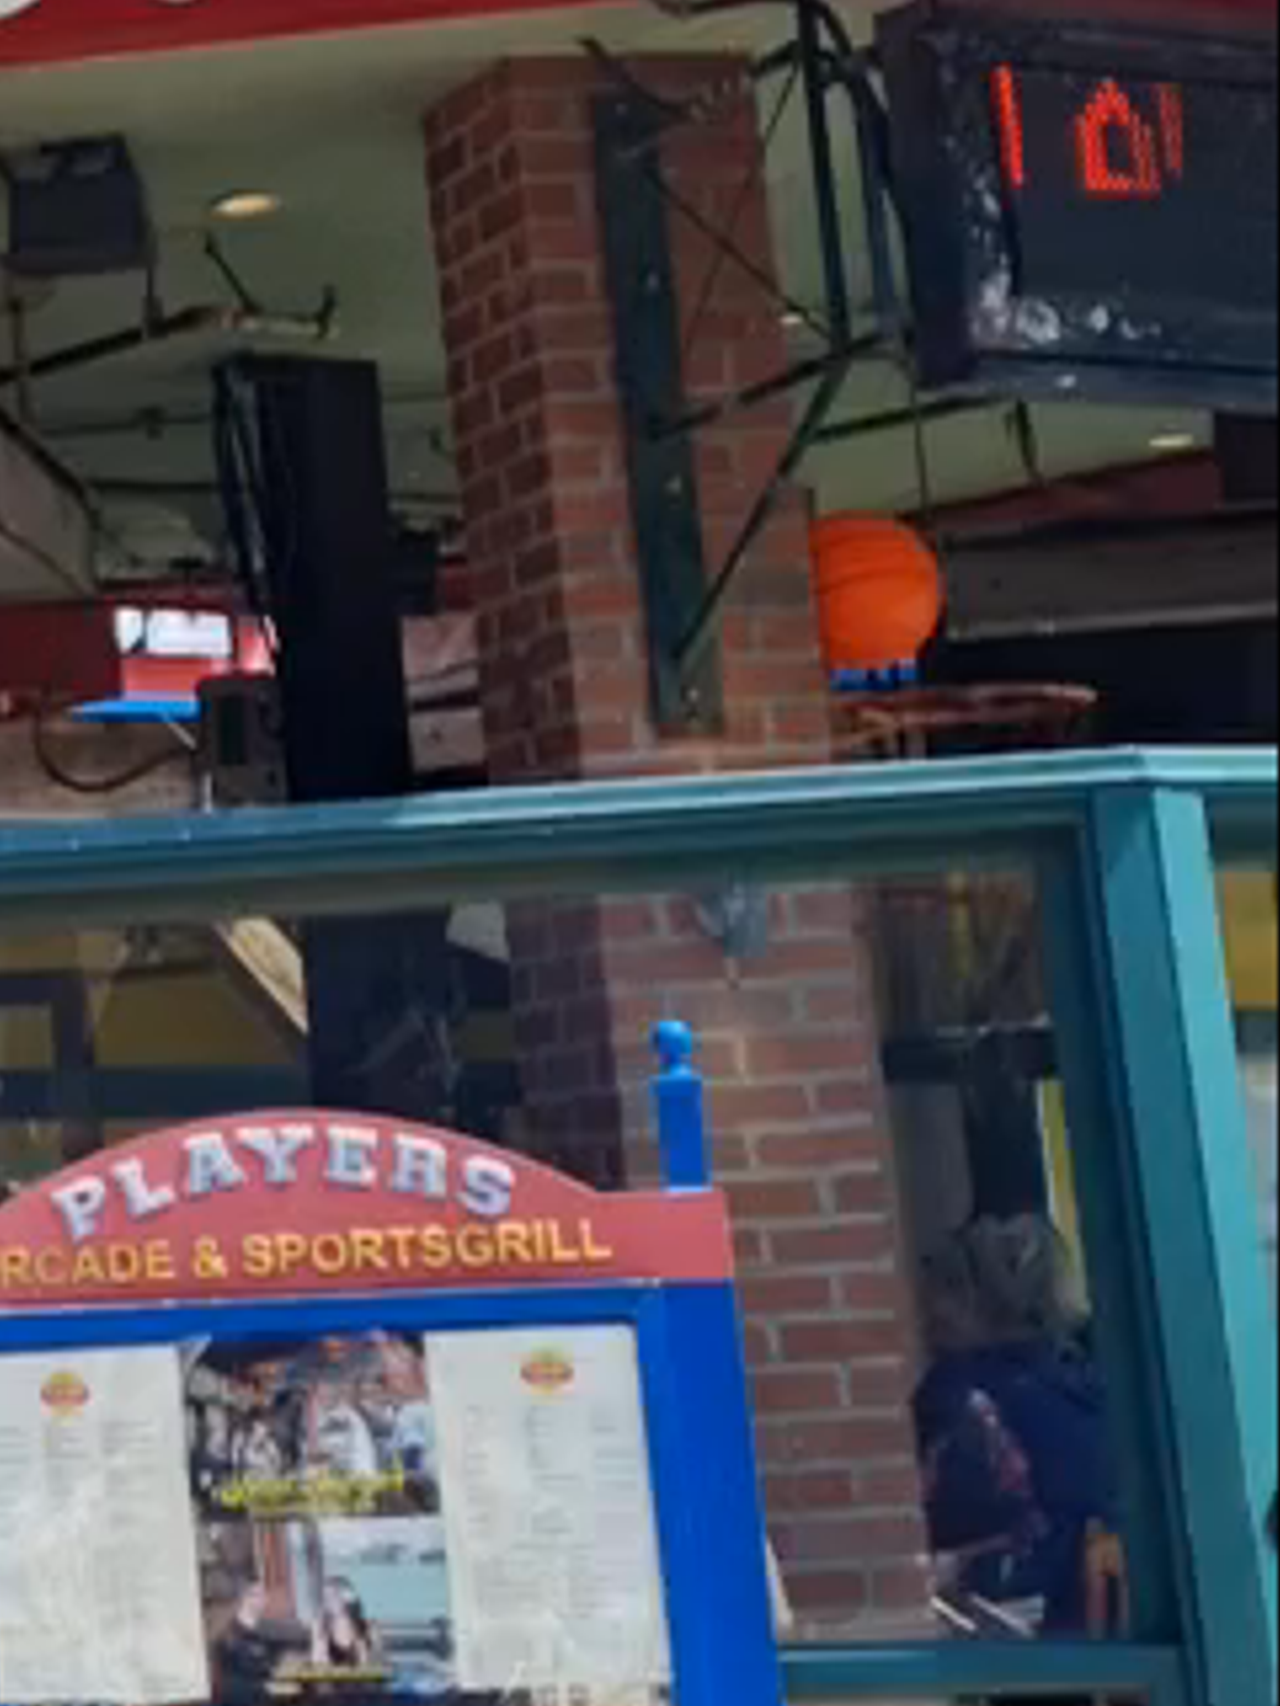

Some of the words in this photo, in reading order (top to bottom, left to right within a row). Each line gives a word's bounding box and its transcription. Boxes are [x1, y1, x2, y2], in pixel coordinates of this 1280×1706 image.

[47, 1121, 518, 1242] PLAYERS
[193, 1237, 229, 1278] &
[241, 1219, 612, 1278] SPORTSGRILL
